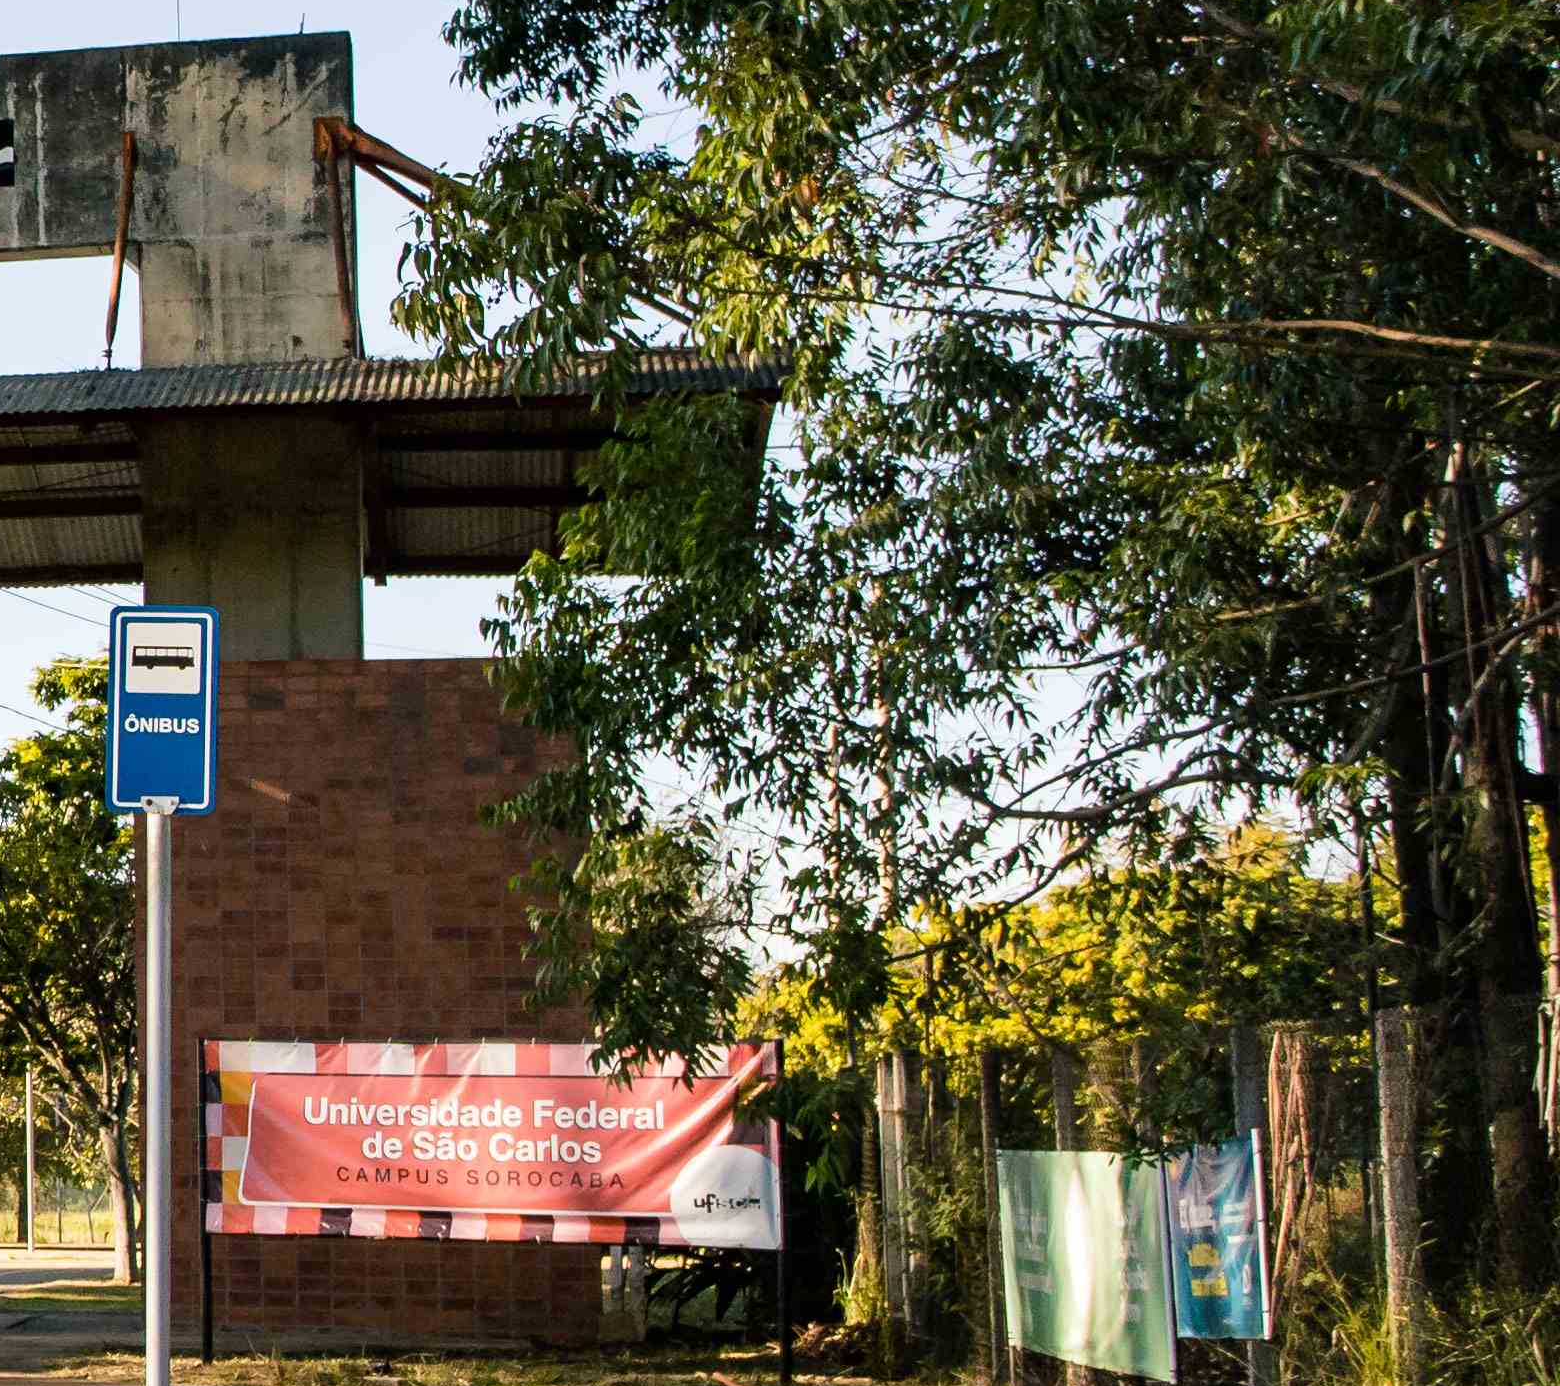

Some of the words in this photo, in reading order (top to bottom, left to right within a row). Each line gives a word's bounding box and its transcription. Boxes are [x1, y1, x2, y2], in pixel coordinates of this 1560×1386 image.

[124, 713, 200, 734] ÔNIBUS
[303, 1096, 523, 1127] Universidade
[532, 1099, 665, 1131] Federal
[361, 1132, 404, 1160] de
[412, 1130, 478, 1162] São
[488, 1132, 602, 1164] Carlos
[336, 1166, 449, 1185] CAMPUS
[466, 1169, 625, 1190] SOROCABA
